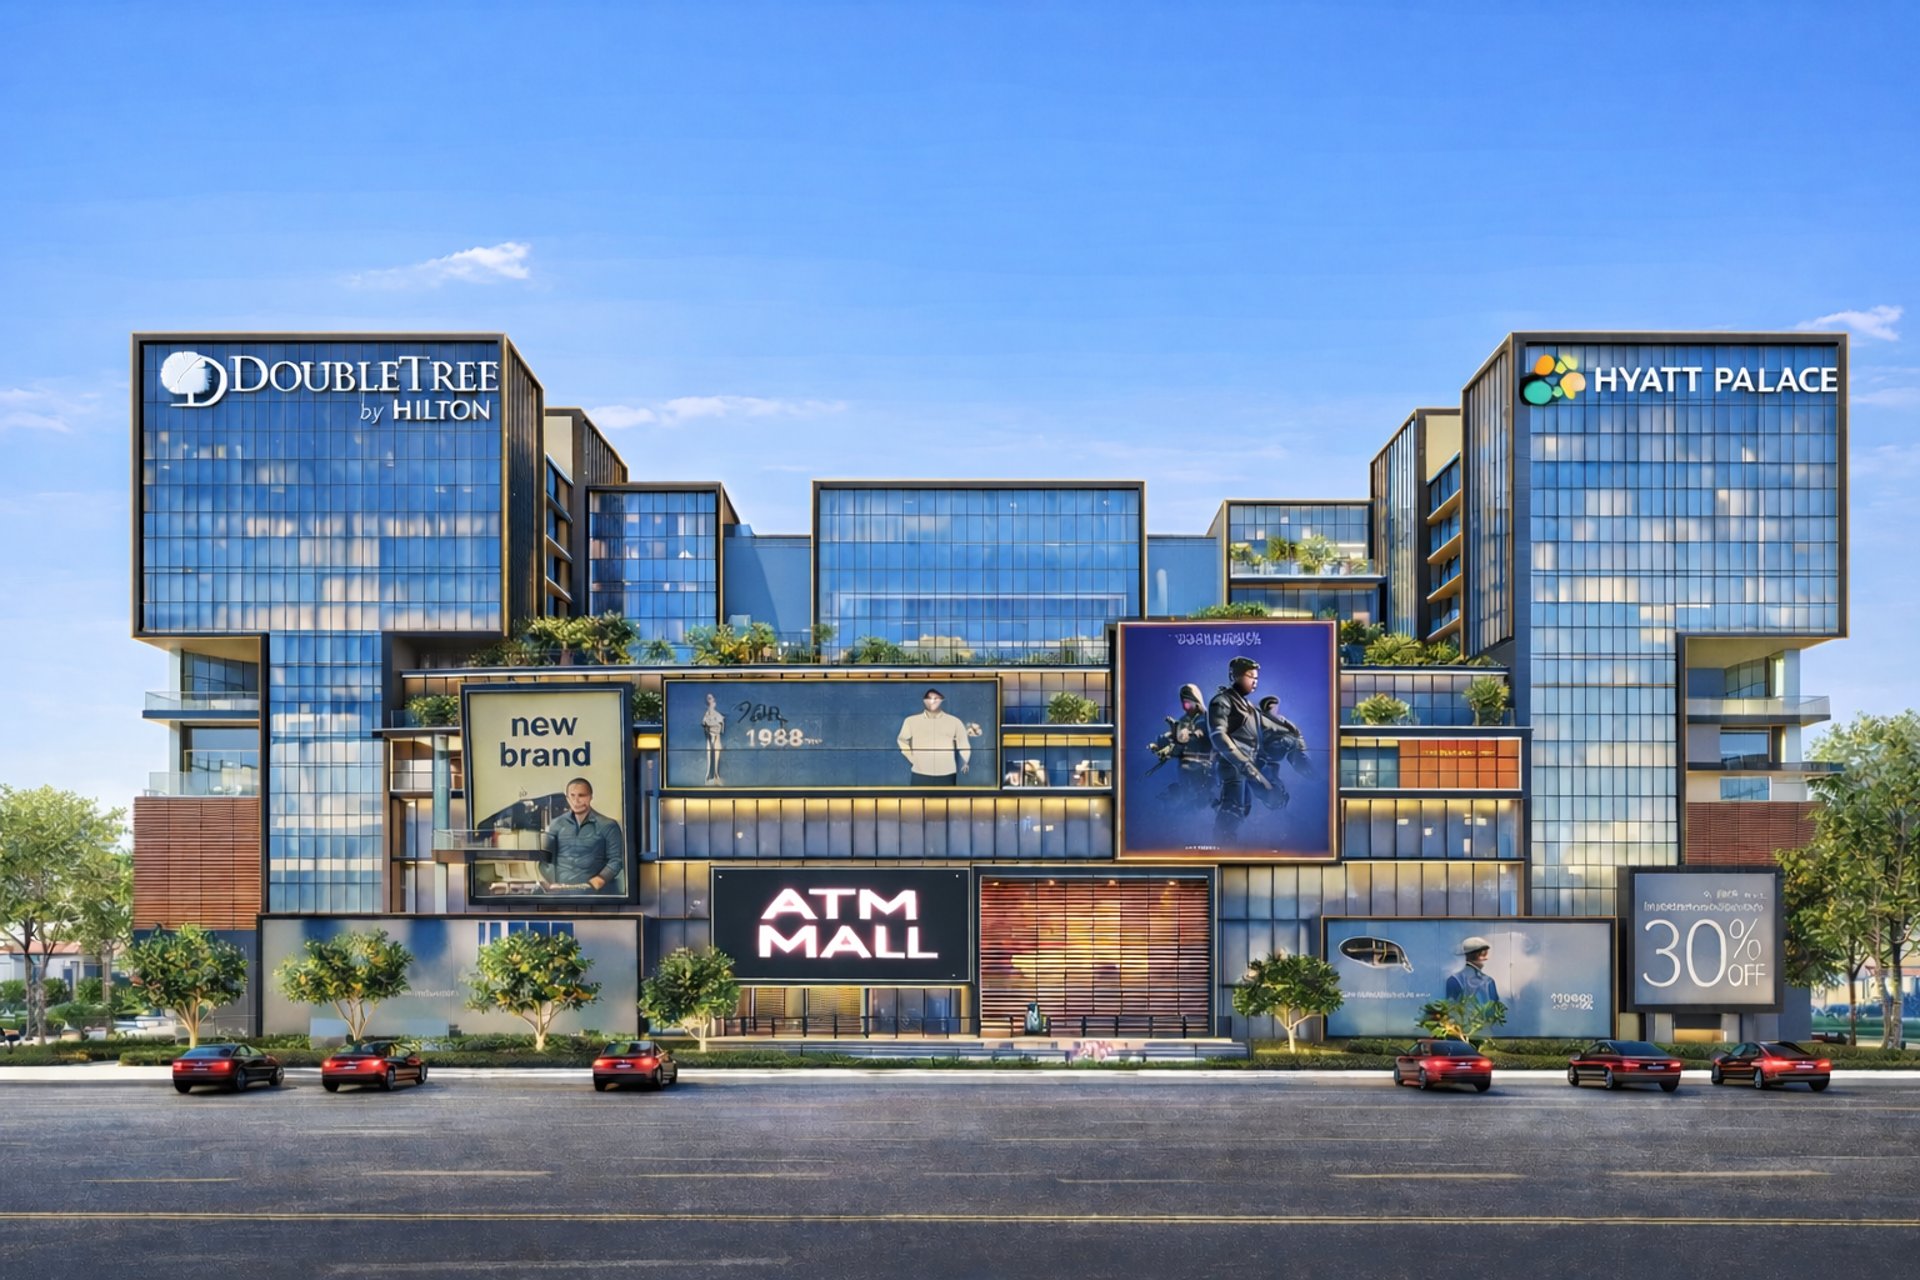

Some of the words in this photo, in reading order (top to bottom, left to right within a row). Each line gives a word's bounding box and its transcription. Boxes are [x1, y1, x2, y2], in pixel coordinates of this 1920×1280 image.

[229, 355, 499, 392] DOUBLETREE
[1594, 367, 1702, 392] HYATT
[1715, 367, 1838, 393] PALACE
[360, 402, 384, 424] by
[392, 399, 491, 421] HILTON
[511, 716, 578, 736] new
[746, 728, 804, 748] 1988
[500, 741, 591, 767] brand
[760, 888, 918, 920] ATM
[758, 925, 939, 959] MALL
[1642, 918, 1762, 988] 30%
[1727, 963, 1767, 987] OFF
